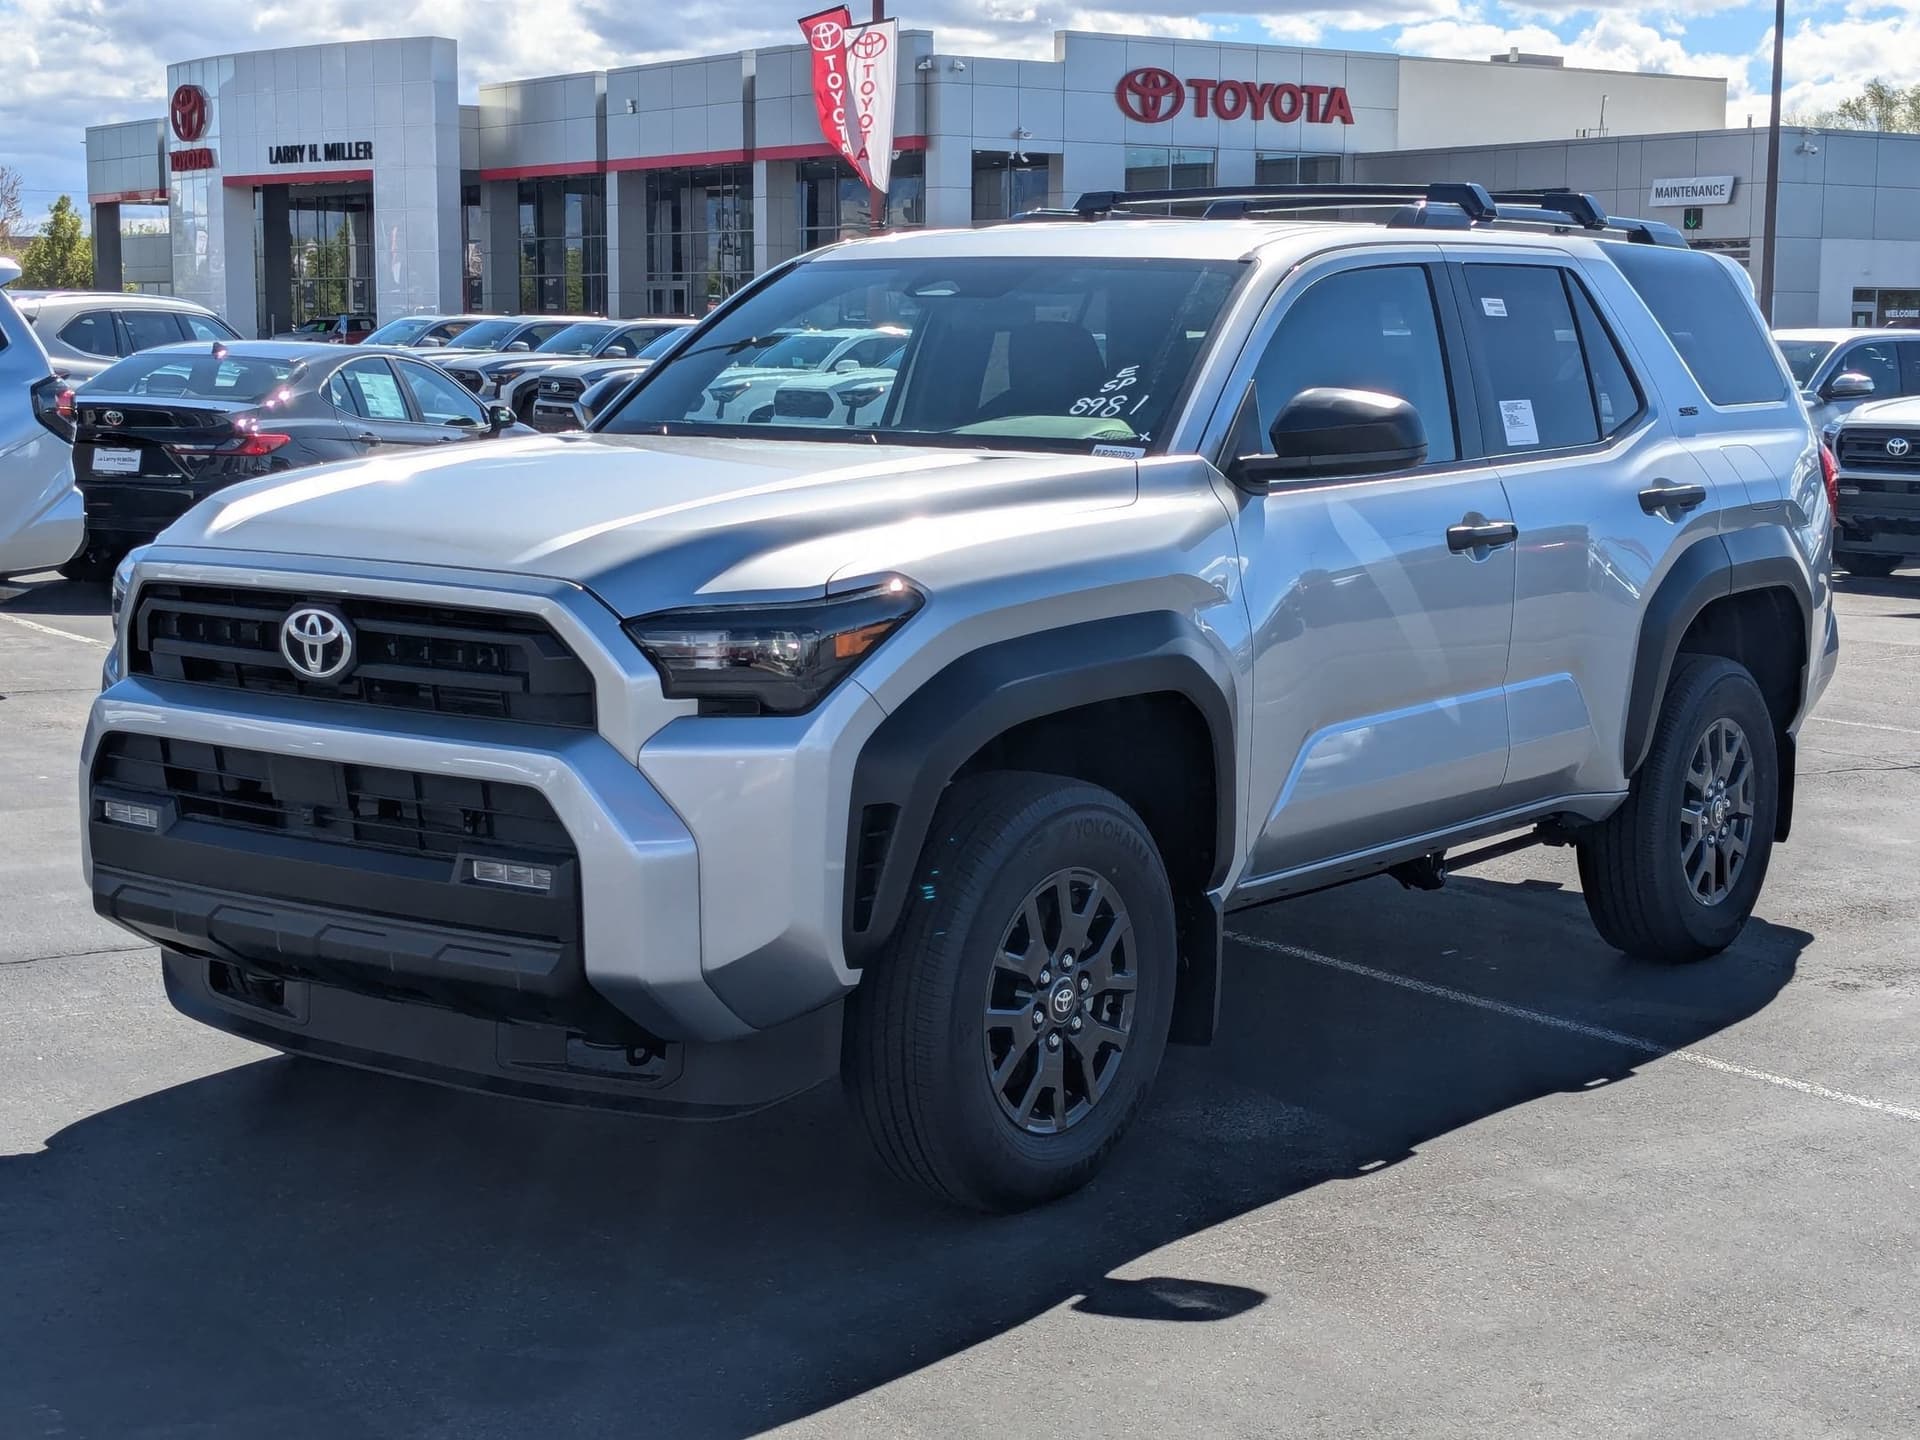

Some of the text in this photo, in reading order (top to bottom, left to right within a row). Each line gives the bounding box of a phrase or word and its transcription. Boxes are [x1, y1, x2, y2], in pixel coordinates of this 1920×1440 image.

[1187, 78, 1355, 124] TOYOTA
[857, 64, 876, 161] TOYOTA
[170, 148, 214, 172] TOYOTA
[269, 141, 373, 164] LARRY H. MILLER
[1655, 184, 1725, 199] MAINTENANCE
[1885, 309, 1920, 318] WELCOME
[1100, 377, 1137, 393] SP
[1069, 395, 1149, 417] 8981
